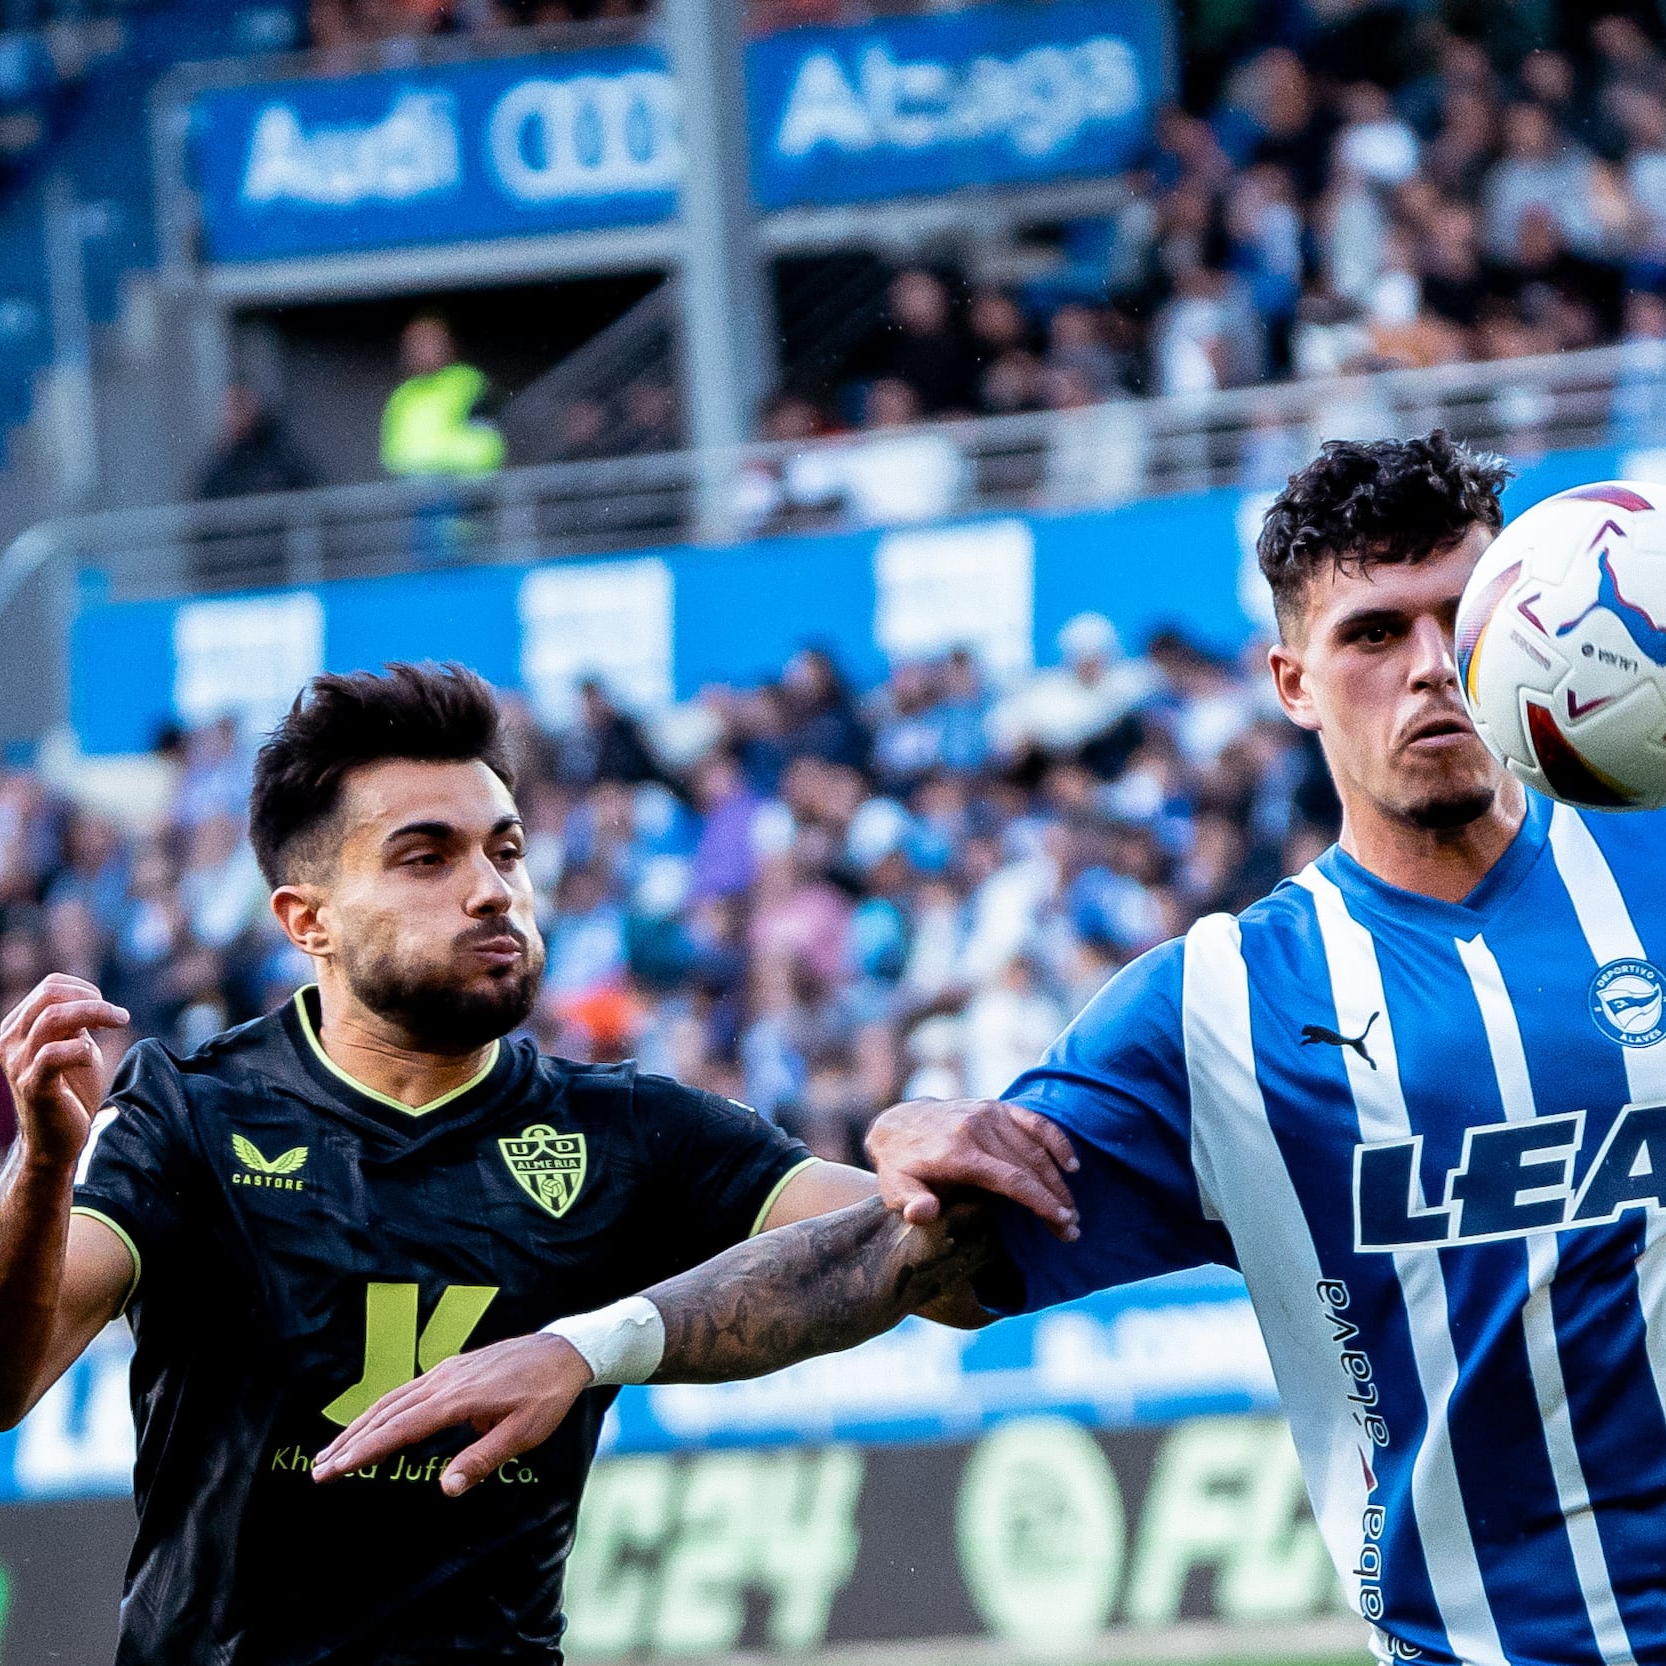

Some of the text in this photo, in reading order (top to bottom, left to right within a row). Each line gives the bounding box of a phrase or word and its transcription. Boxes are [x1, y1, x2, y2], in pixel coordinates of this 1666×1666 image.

[516, 1159, 578, 1171] ALMERIA
[232, 1173, 304, 1191] CASTORE
[1317, 1278, 1391, 1448] álava
[498, 1458, 539, 1484] Co.
